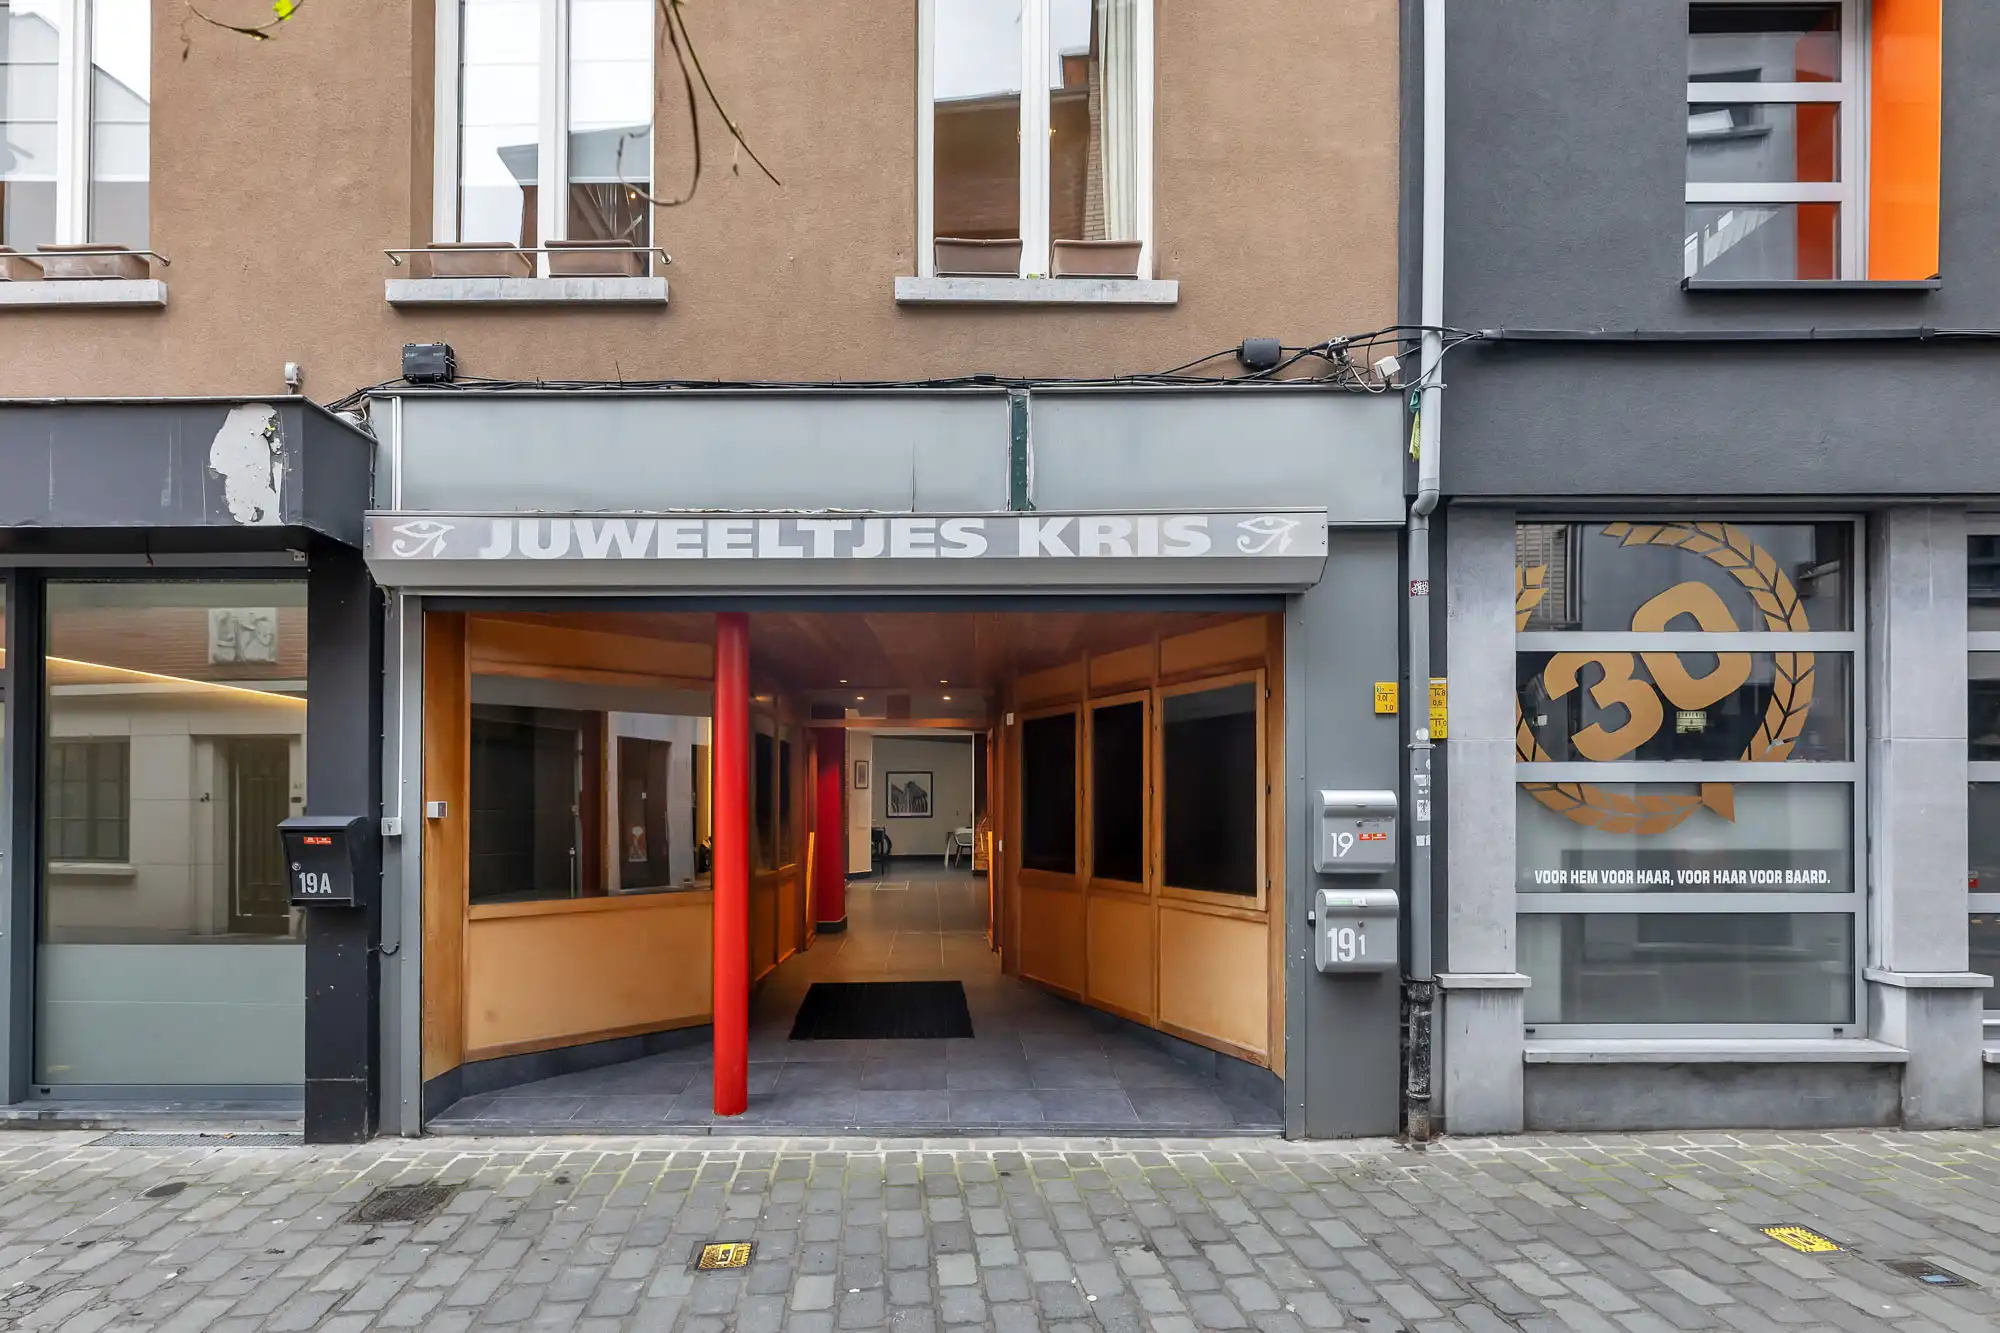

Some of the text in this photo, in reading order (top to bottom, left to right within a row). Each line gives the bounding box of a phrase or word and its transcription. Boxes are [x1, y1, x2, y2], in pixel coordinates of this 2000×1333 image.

[478, 516, 1211, 559] JUWEELTJES KRIS
[1543, 581, 1752, 762] 30
[1330, 832, 1354, 857] 19
[1534, 869, 1831, 886] VOOR HEM VOOR HAAR, VOOR HAAR VOOR BAARD.
